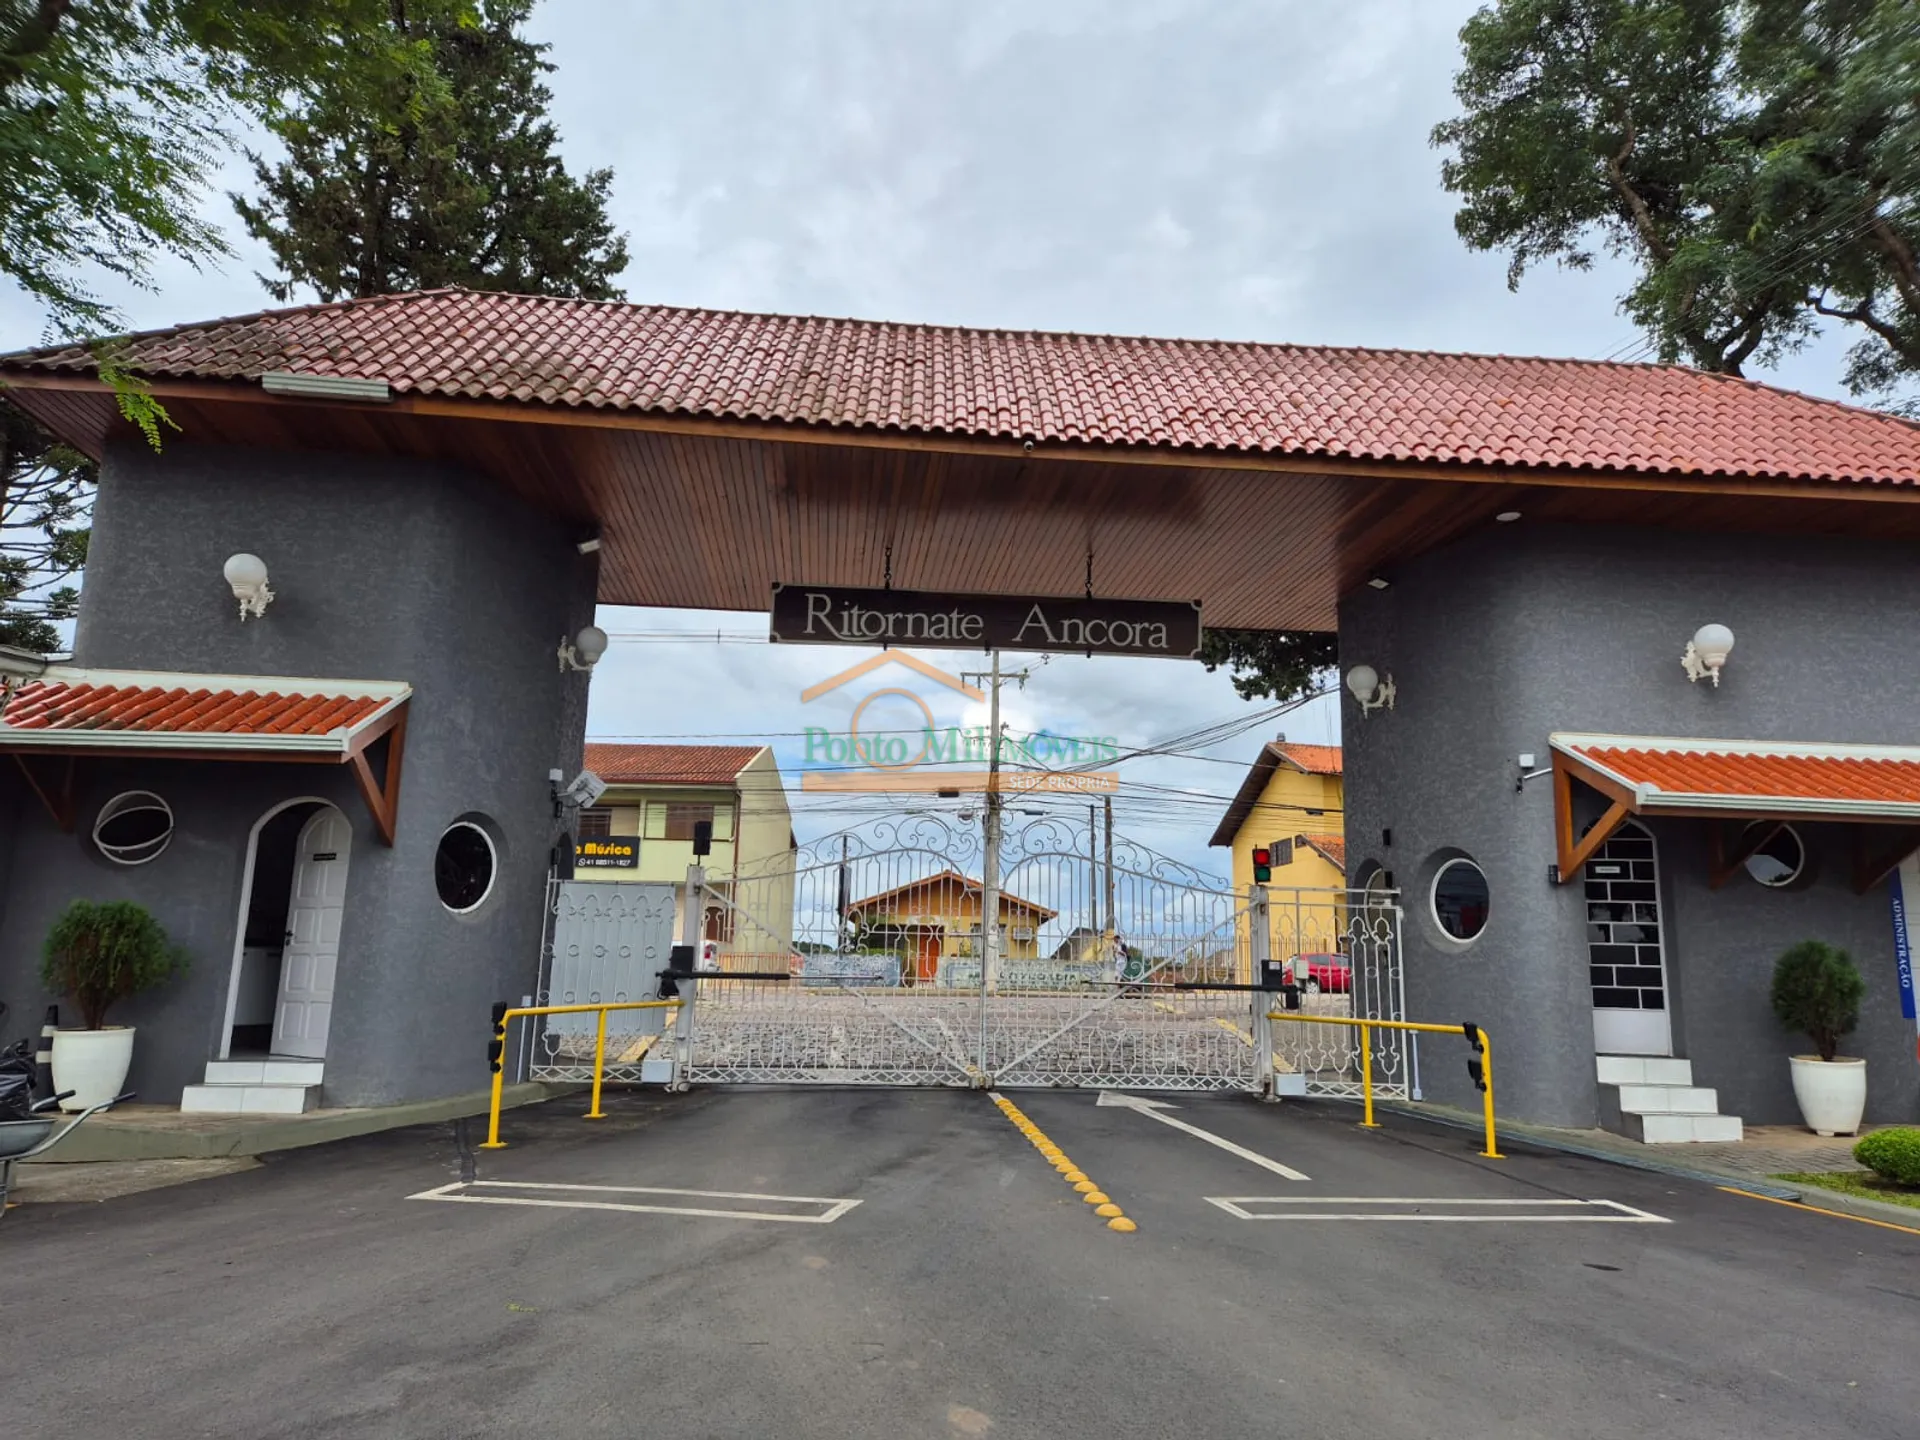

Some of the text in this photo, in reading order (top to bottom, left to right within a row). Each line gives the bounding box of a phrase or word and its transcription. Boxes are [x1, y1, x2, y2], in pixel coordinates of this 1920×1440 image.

[804, 593, 1169, 648] Ritornate Ancora
[585, 842, 631, 856] Música
[1893, 899, 1911, 988] ADMINISTRAÇÃO
